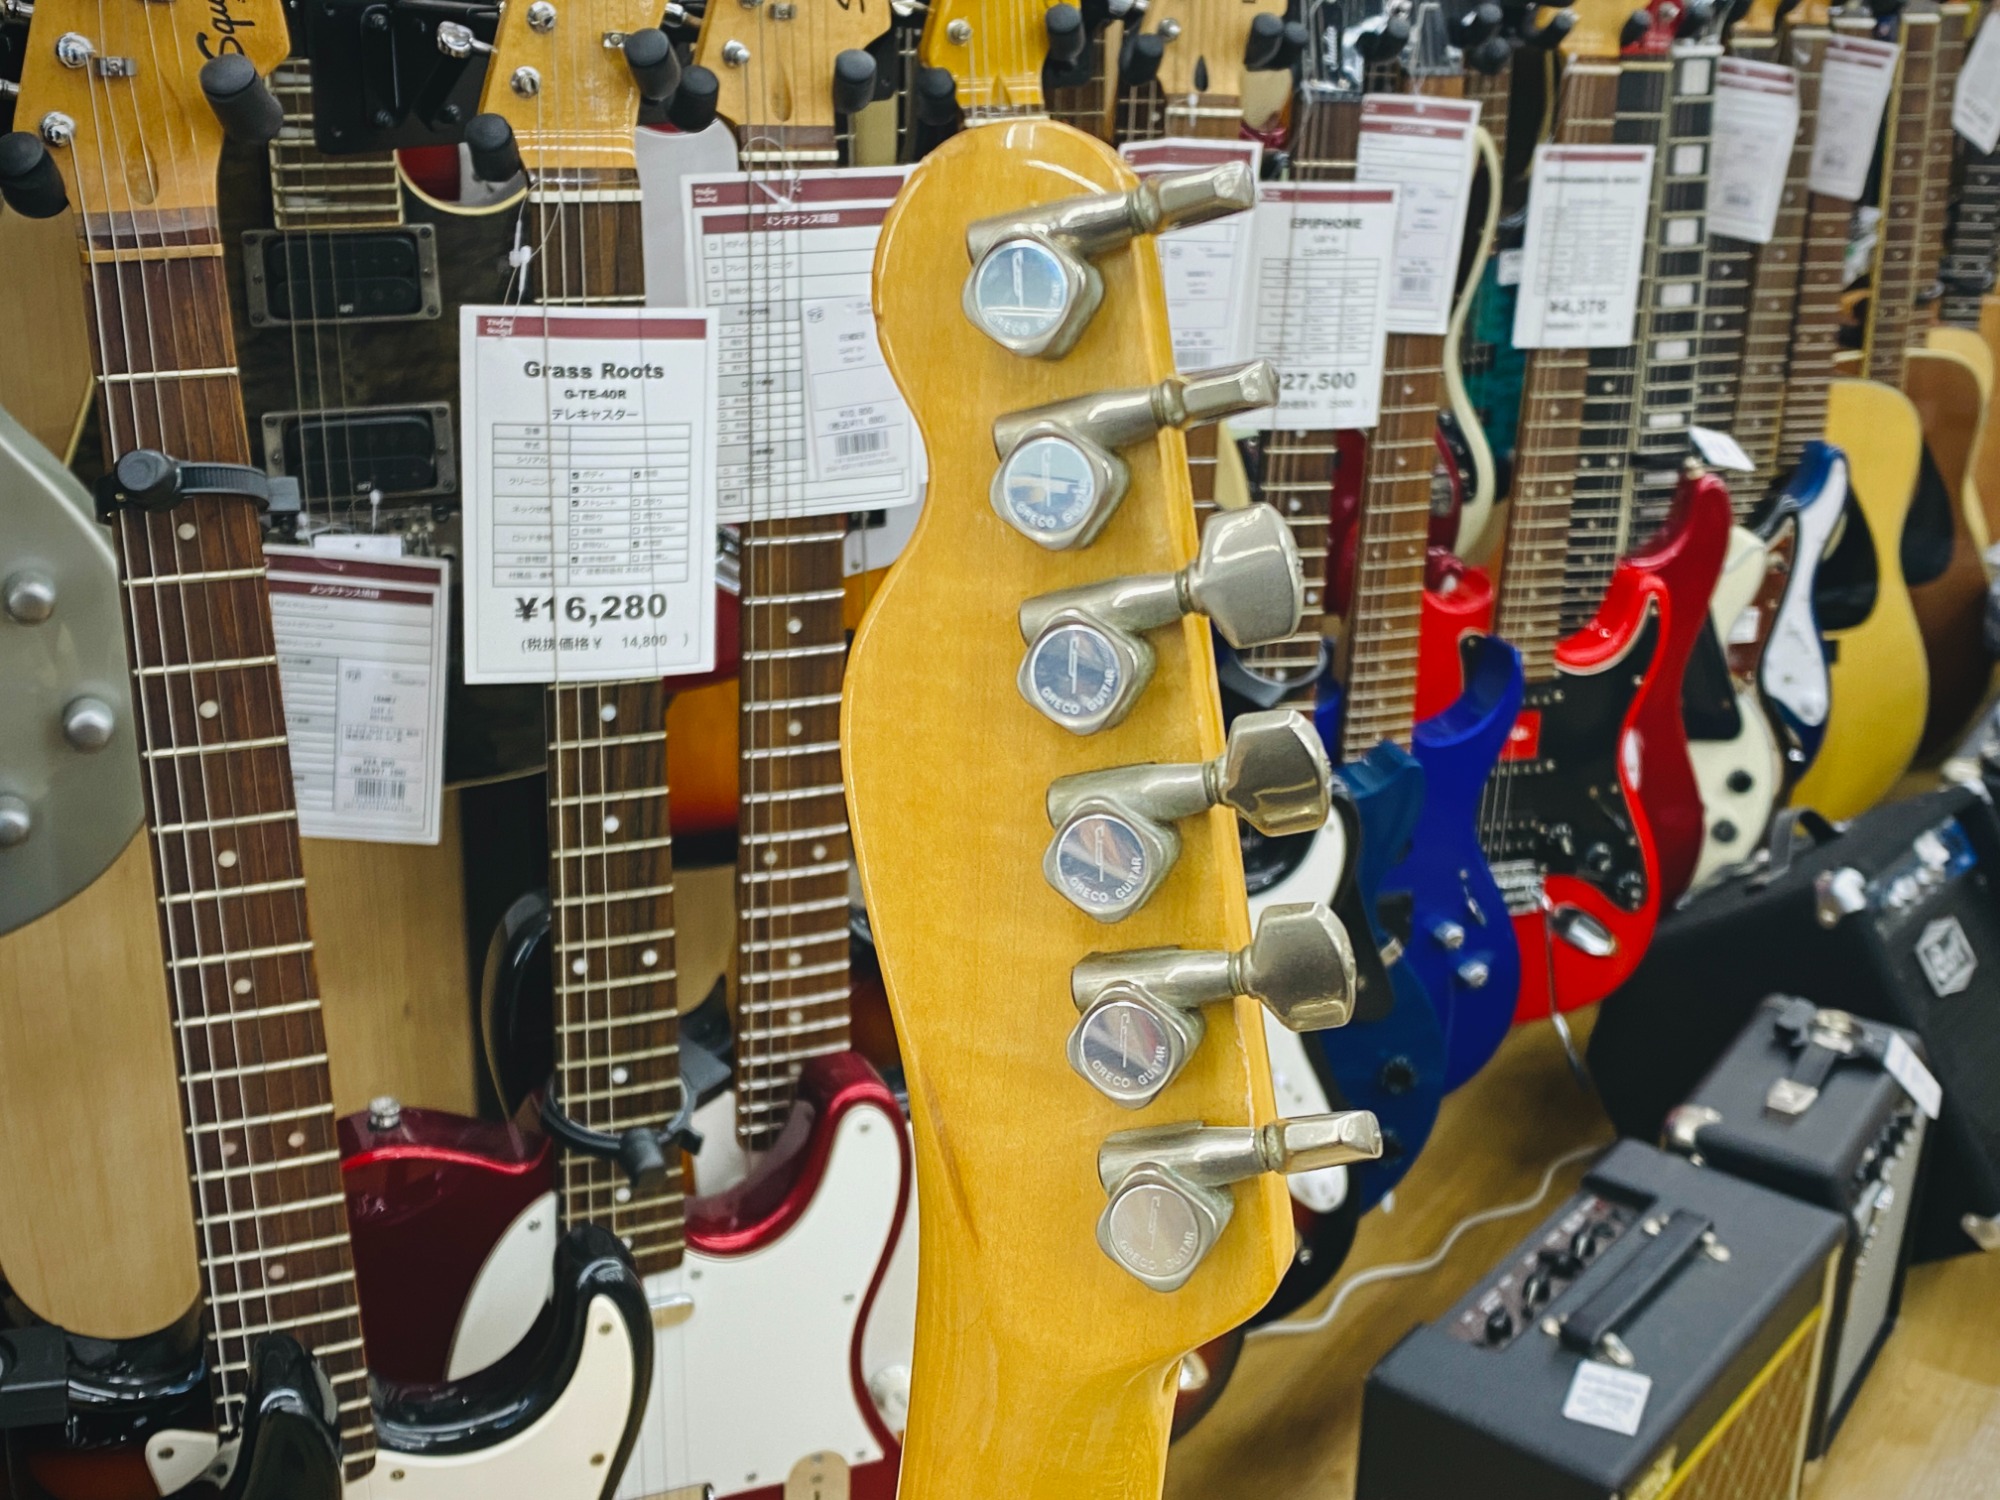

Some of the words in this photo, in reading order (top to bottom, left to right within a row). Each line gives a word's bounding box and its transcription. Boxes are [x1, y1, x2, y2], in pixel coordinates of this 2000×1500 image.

[523, 361, 593, 380] Grass
[601, 361, 665, 380] Roots
[564, 389, 627, 400] G-TE-40R
[551, 408, 639, 421] テレキャスター
[1016, 501, 1057, 529] GRECO
[514, 592, 668, 629] ¥16,280
[1041, 686, 1081, 715] GRECO
[1086, 668, 1116, 712] GUITAR
[1069, 876, 1109, 903] GRECO
[1115, 856, 1143, 900] GUITAR
[1092, 1059, 1131, 1088] GRECO
[1137, 1045, 1166, 1086] GUITAR
[1119, 1239, 1158, 1271] GRECO
[1165, 1231, 1195, 1271] GUITAR
